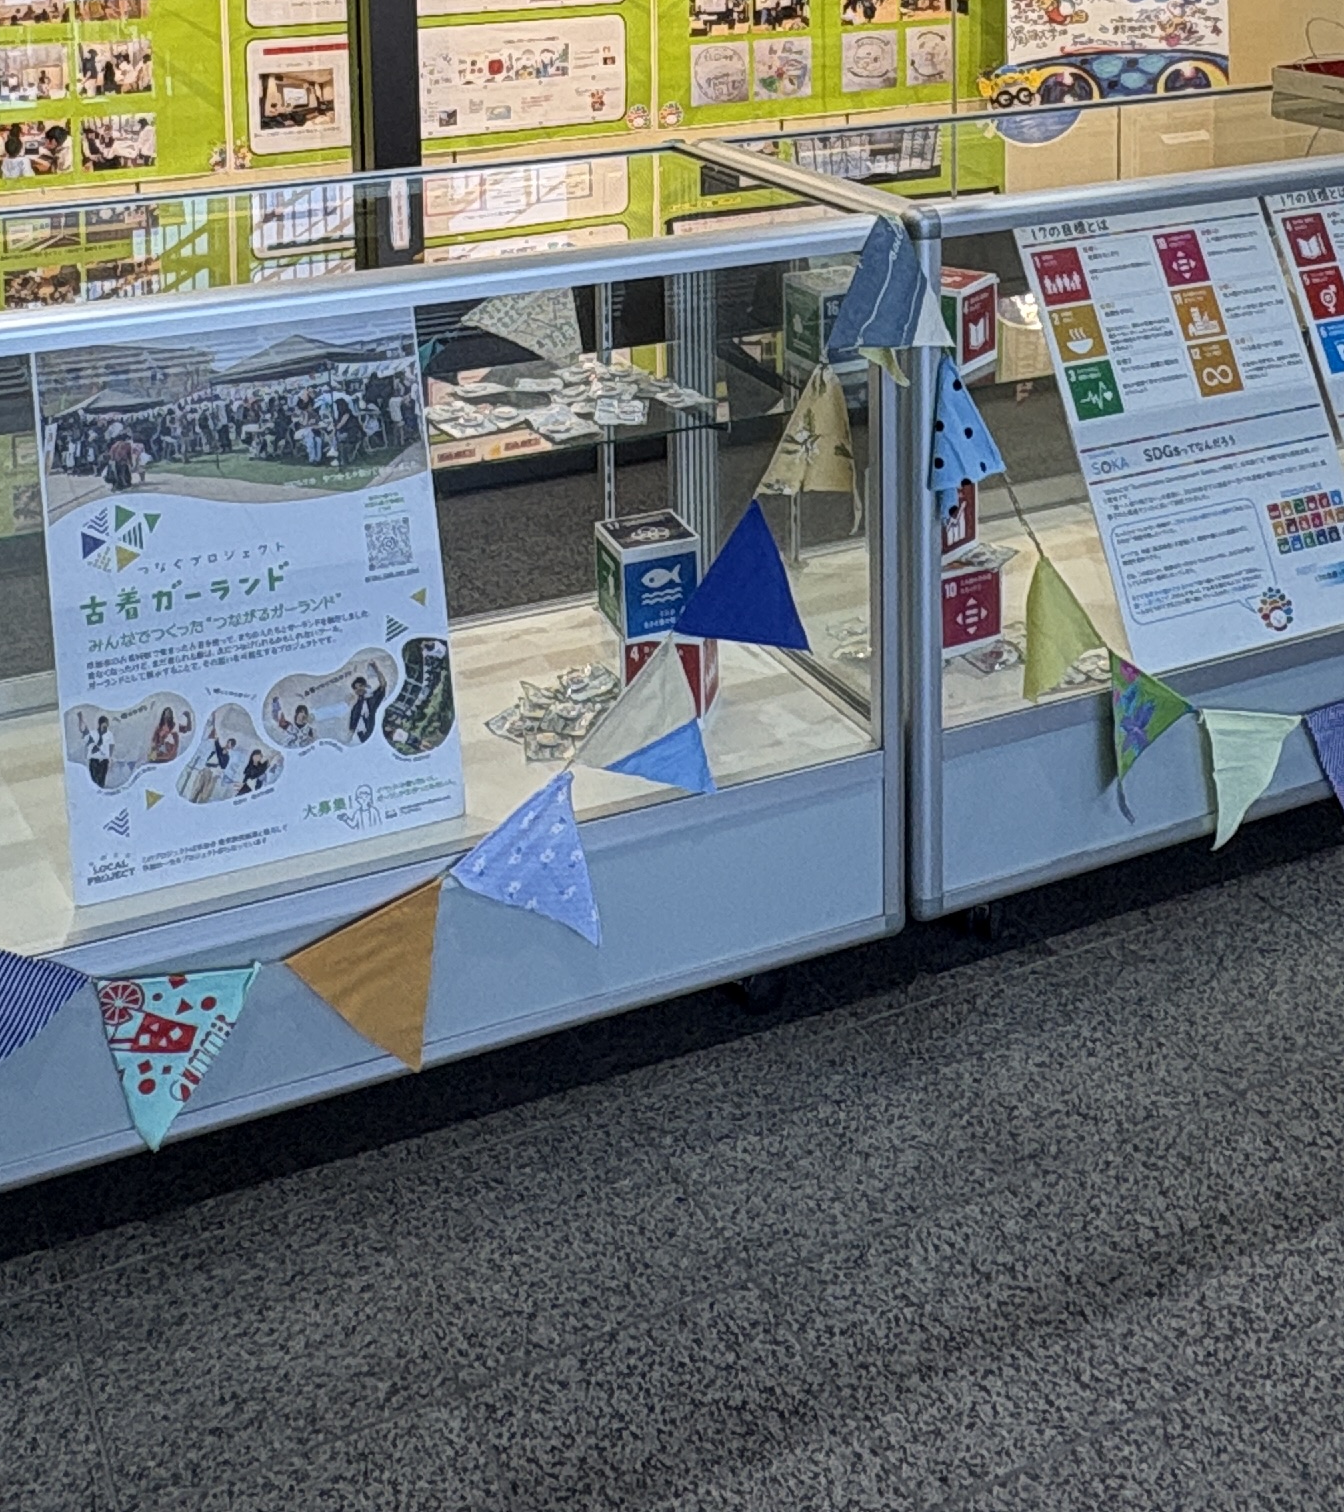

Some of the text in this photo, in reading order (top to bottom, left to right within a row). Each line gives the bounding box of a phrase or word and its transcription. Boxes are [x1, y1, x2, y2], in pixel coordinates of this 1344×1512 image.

[825, 300, 840, 316] 16
[136, 540, 287, 576] つなぐプロジェクト
[79, 559, 290, 626] 古着ガーランド
[943, 582, 958, 599] 10
[629, 645, 640, 662] 4
[92, 859, 130, 875] LOCAL
[87, 866, 136, 887] PROJECT
